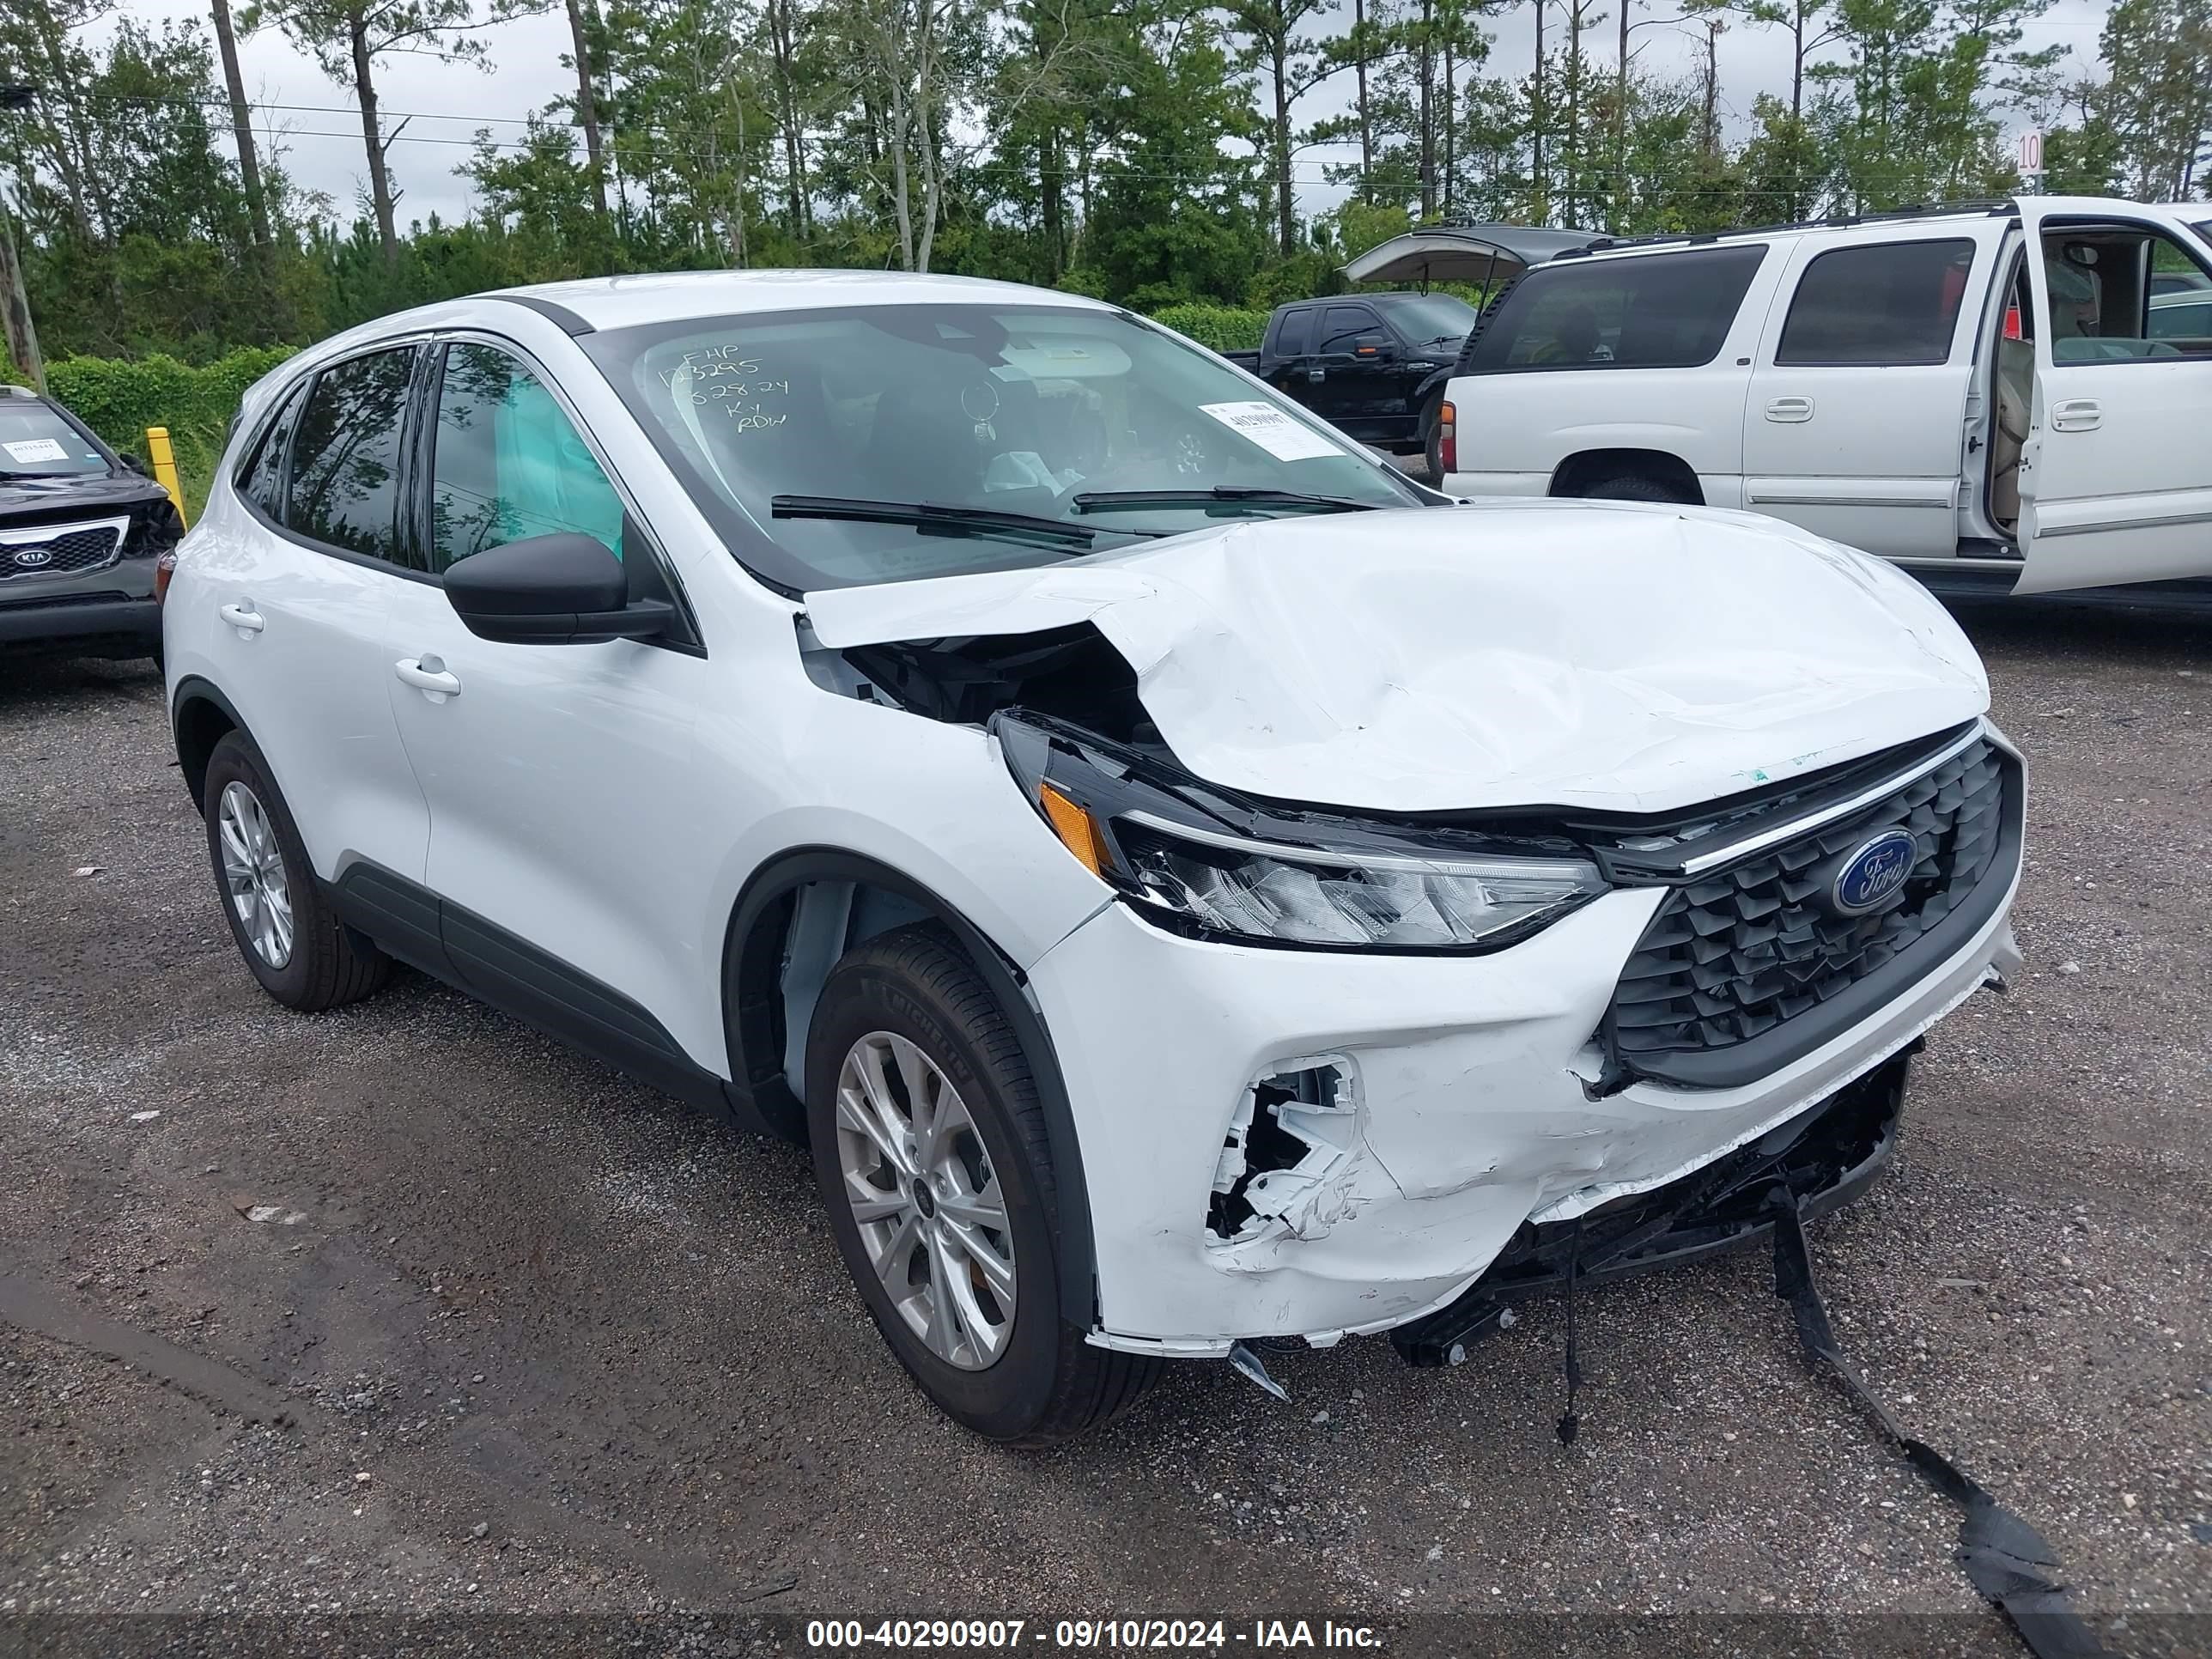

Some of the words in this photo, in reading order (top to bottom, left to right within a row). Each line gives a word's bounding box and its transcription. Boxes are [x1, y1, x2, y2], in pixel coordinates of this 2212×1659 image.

[2020, 135, 2039, 169] 10
[683, 344, 739, 364] FHP
[21, 552, 45, 563] KIA
[1859, 848, 1905, 900] Ford
